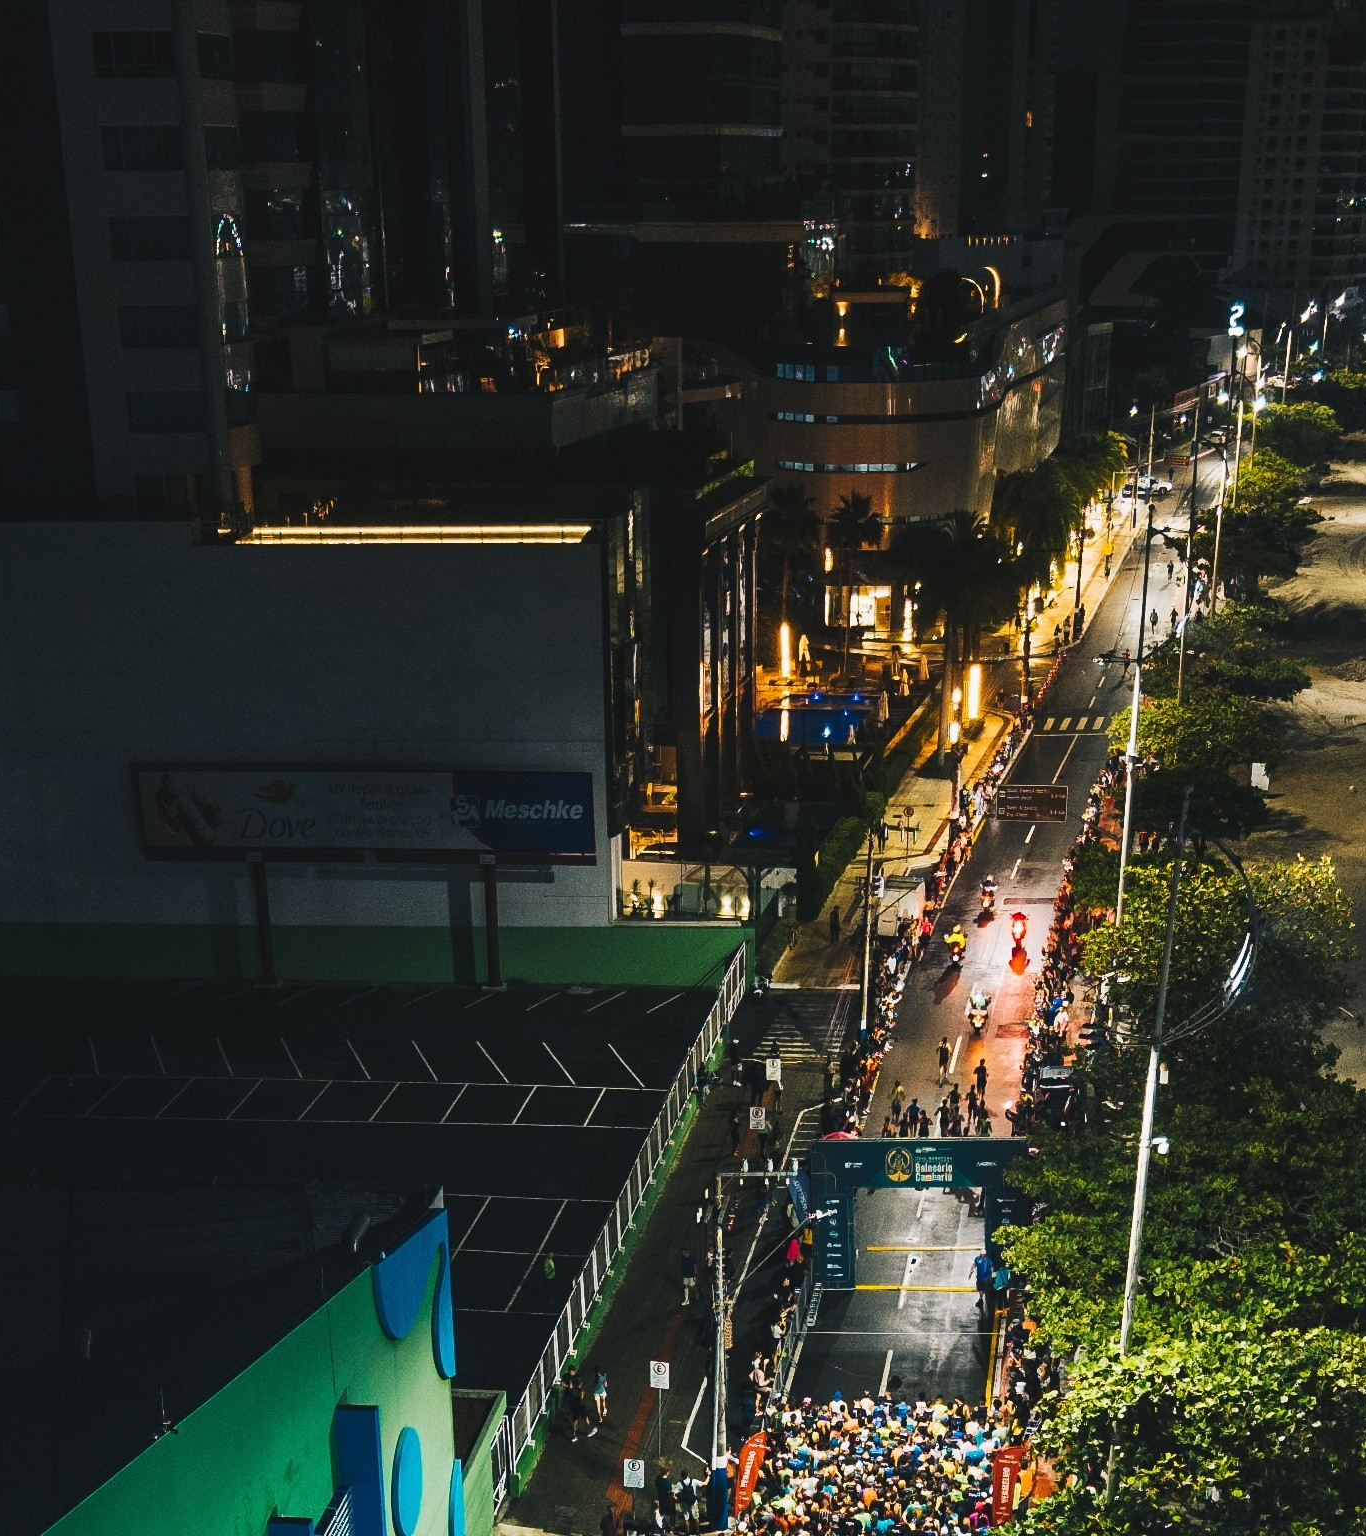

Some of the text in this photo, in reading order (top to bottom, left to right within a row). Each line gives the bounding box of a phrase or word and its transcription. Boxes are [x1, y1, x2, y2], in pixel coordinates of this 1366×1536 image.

[484, 799, 584, 820] Meschke
[239, 806, 316, 839] Dove
[915, 1162, 953, 1173] Balneário
[915, 1172, 953, 1182] Caboriú
